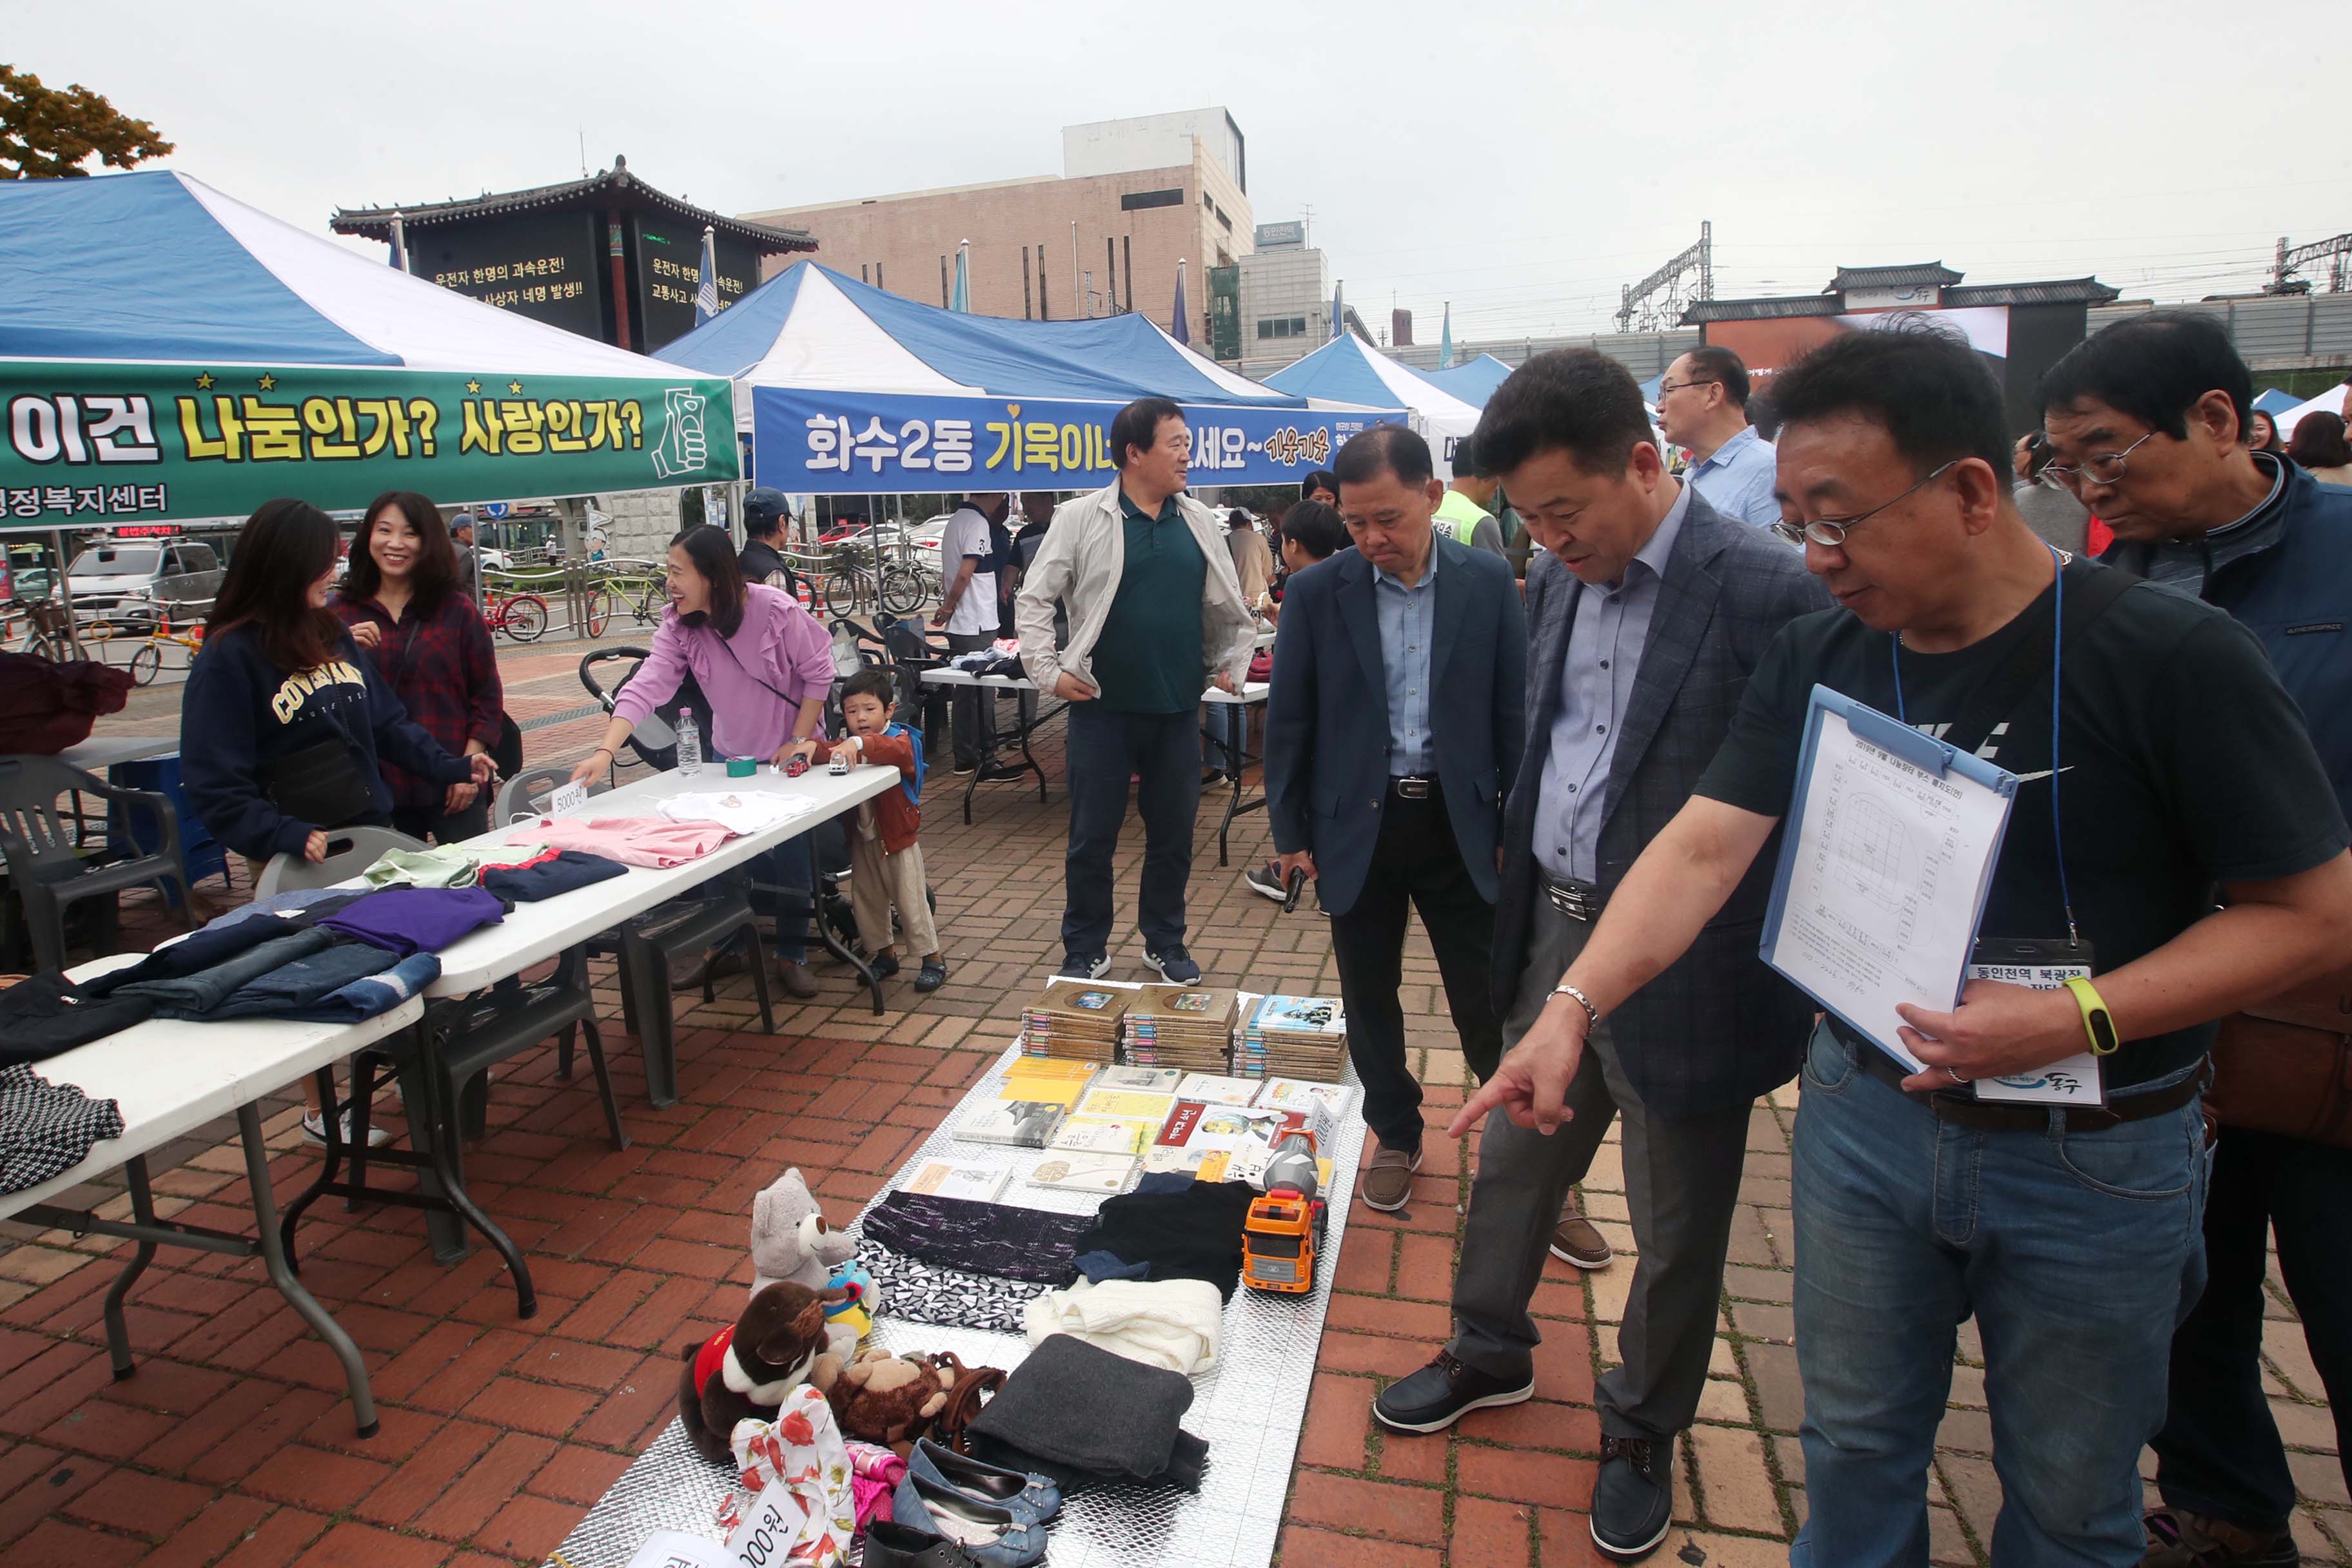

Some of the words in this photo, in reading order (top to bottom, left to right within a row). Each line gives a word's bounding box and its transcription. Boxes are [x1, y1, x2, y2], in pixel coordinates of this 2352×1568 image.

[435, 270, 469, 288] 운전자
[473, 264, 508, 284] 한명의
[513, 257, 565, 278] 과속운전!
[653, 258, 680, 279] 운전자
[682, 266, 701, 283] 한명
[715, 276, 743, 293] 속운전!
[485, 290, 518, 307] 사상자
[523, 286, 546, 303] 네명
[551, 282, 582, 300] 발생!!
[652, 284, 687, 303] 교통사고
[8, 393, 162, 464] 이건
[175, 395, 439, 462] 나눔인가?
[460, 398, 644, 456] 사랑인가?
[805, 413, 973, 473] 화수2동
[1265, 426, 1331, 467] 기웃기웃
[979, 538, 985, 553] 3
[1856, 740, 1876, 755] 2019년
[558, 785, 582, 812] 5000원
[1977, 967, 2031, 980] 동인천역
[2044, 1072, 2082, 1094] 동구
[1169, 1120, 1186, 1141] 까마귀
[1179, 1109, 1197, 1121] 소년
[1315, 1111, 1333, 1147] 1000원
